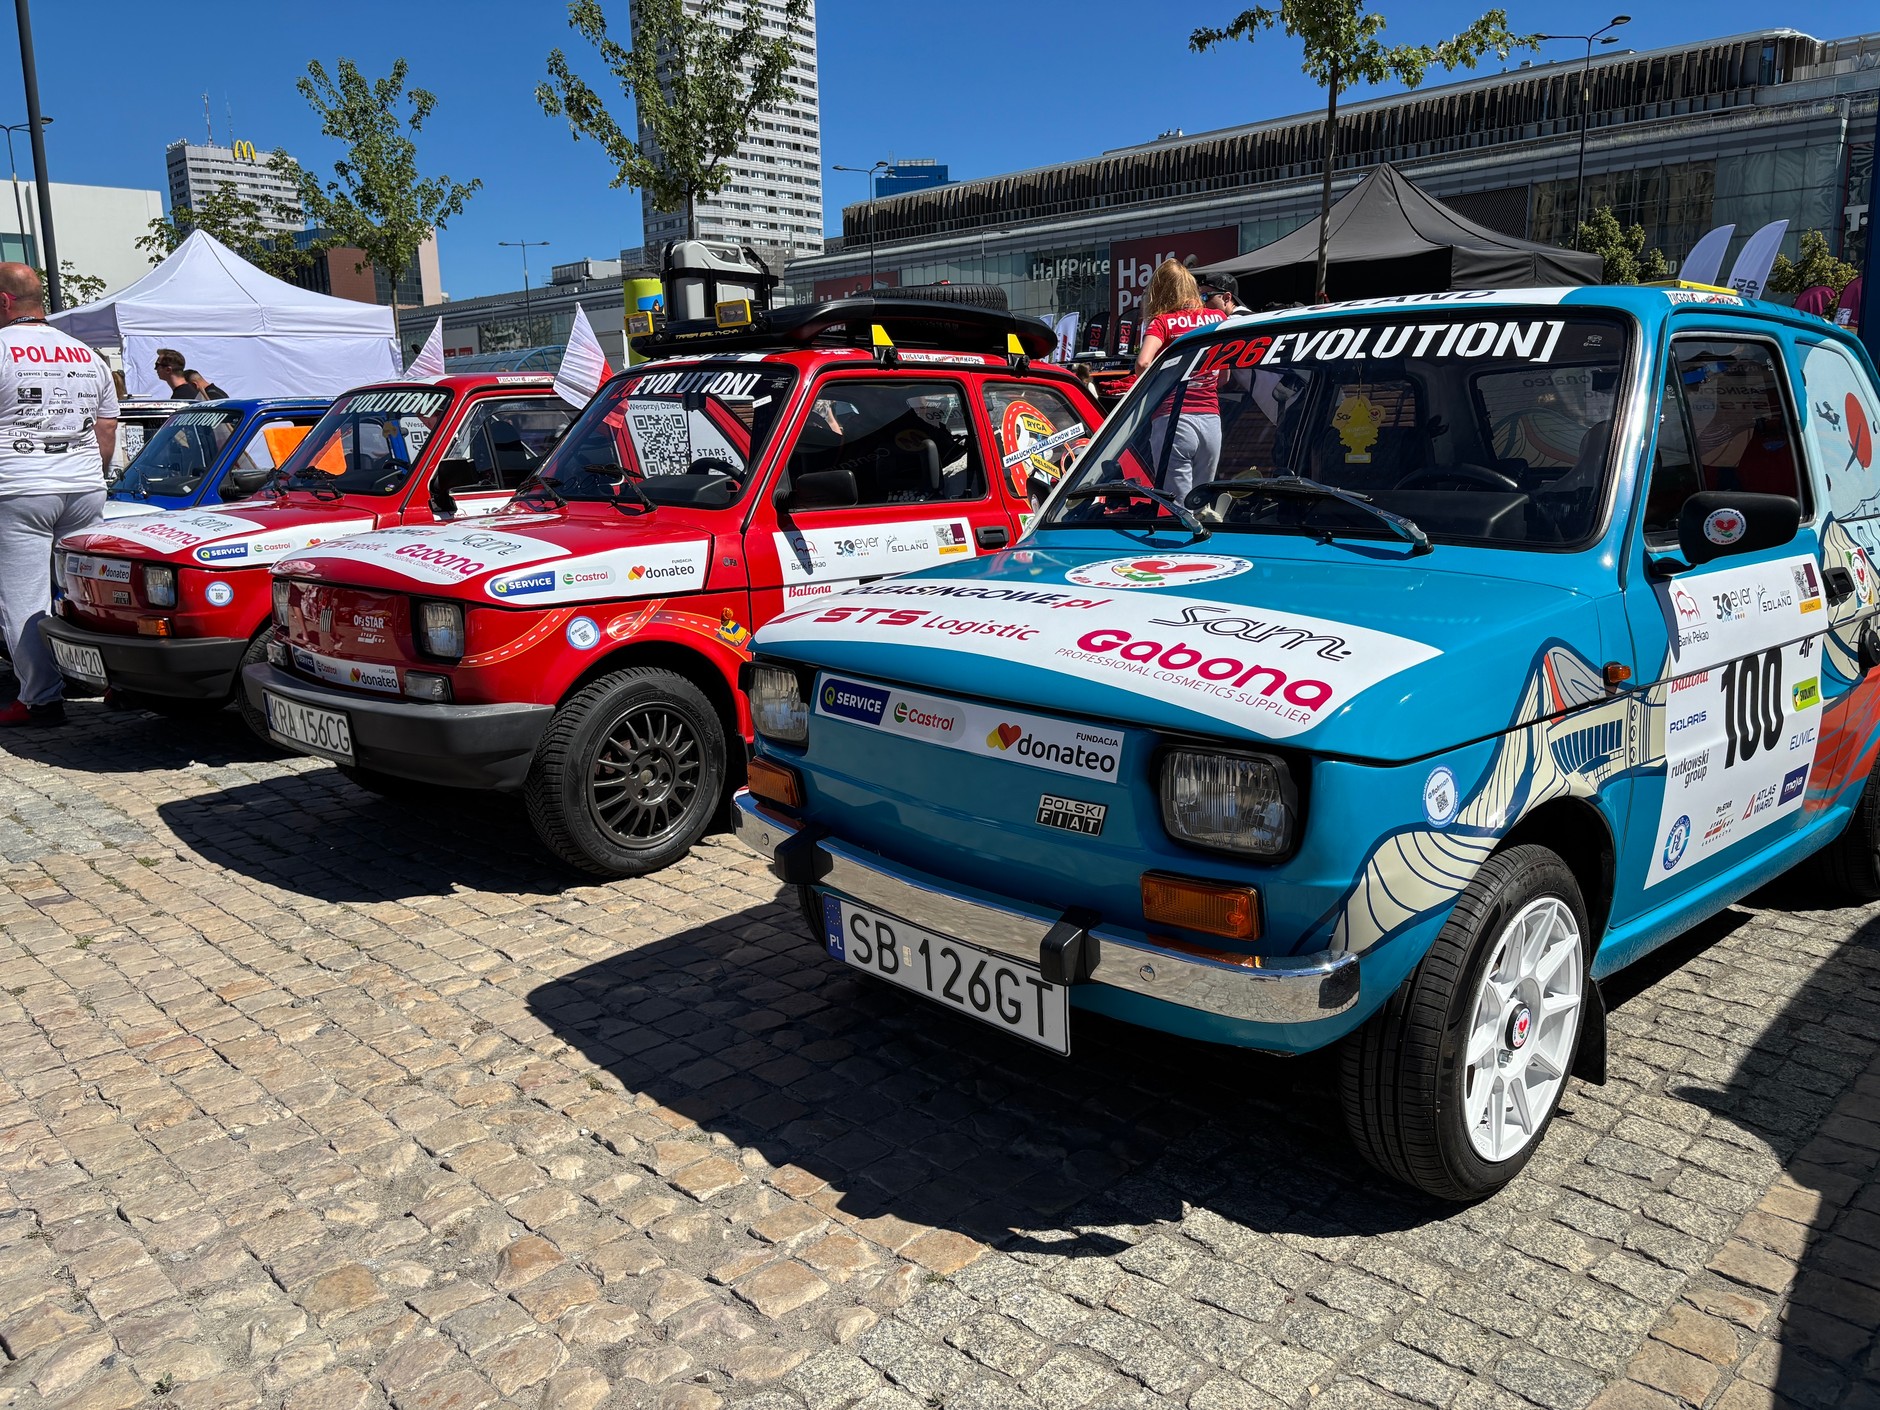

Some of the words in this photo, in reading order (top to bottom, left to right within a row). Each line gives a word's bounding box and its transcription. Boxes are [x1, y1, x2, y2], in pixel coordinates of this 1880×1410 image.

[1033, 258, 1110, 282] HalfPrice
[10, 346, 92, 363] POLAND
[628, 402, 660, 412] Wesprzyj
[660, 402, 682, 411] Dzieci
[1026, 420, 1047, 432] RYGA
[1069, 426, 1081, 436] 2025
[696, 448, 727, 457] STARS
[210, 546, 246, 557] SERVICE
[263, 542, 291, 551] Castrol
[395, 543, 485, 576] Gabona
[790, 561, 807, 571] Bank
[807, 560, 827, 570] Pekao
[105, 567, 130, 579] donateo
[575, 571, 609, 582] Castrol
[645, 563, 695, 579] donateo
[508, 576, 552, 590] SERVICE
[788, 585, 832, 598] Baltona
[813, 606, 931, 626] STS
[921, 614, 1040, 642] Logistic
[1677, 635, 1692, 648] Bank
[1692, 630, 1710, 644] Pekao
[320, 665, 338, 676] Castrol
[1076, 628, 1334, 713] Gabona
[361, 672, 398, 689] donateo
[1055, 648, 1151, 678] PROFESSIONAL
[1153, 670, 1237, 699] COSMETICS
[1235, 691, 1312, 726] SUPPLIER
[836, 690, 882, 715] SERVICE
[1720, 647, 1785, 770] 100
[271, 697, 298, 739] KRA
[299, 709, 350, 753] 156CG
[908, 708, 955, 732] Castrol
[1669, 710, 1707, 734] POLARIS
[1076, 731, 1119, 748] FUNDACJA
[1016, 733, 1116, 774] donateo
[1671, 749, 1710, 779] rutkowski
[1684, 766, 1708, 789] group
[1756, 783, 1777, 801] ATLAS
[1042, 796, 1104, 818] POLSKI
[1753, 796, 1774, 815] WARD
[1038, 808, 1100, 834] FIAT
[829, 933, 844, 951] PL
[849, 913, 899, 976] SB
[918, 938, 1054, 1038] 126GT
